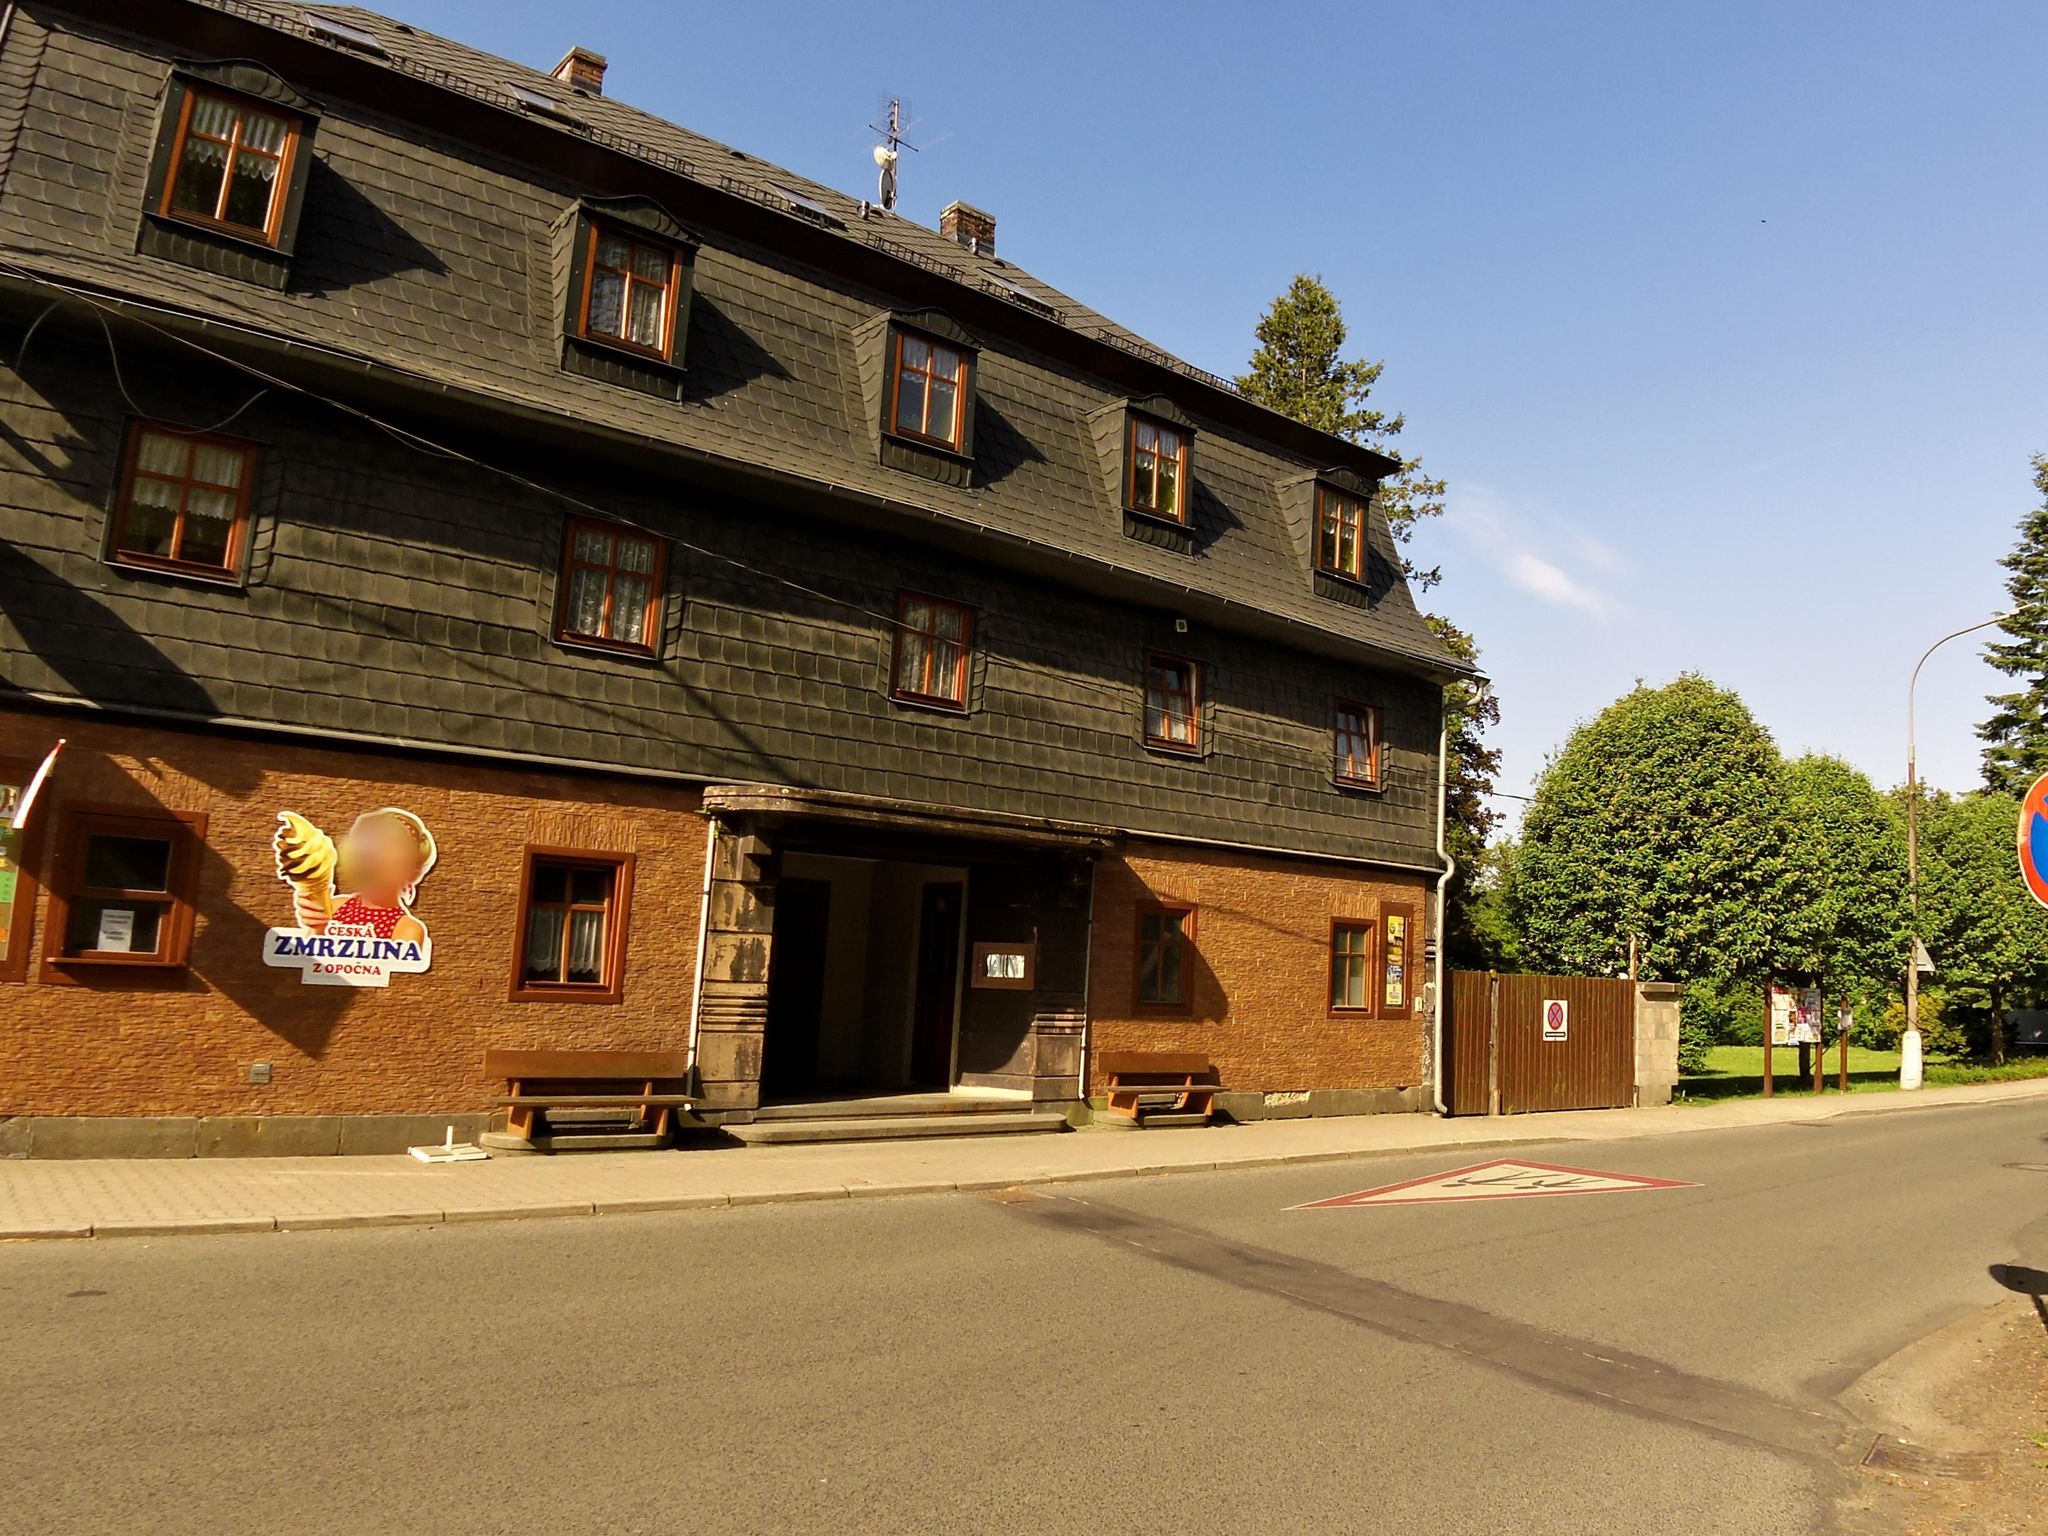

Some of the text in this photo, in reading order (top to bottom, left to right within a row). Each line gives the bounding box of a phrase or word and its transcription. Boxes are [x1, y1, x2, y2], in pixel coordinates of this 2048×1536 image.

[328, 922, 373, 936] ČESKÁ
[274, 936, 421, 961] ZMRZLINA
[312, 962, 381, 976] Z OPOČNA
